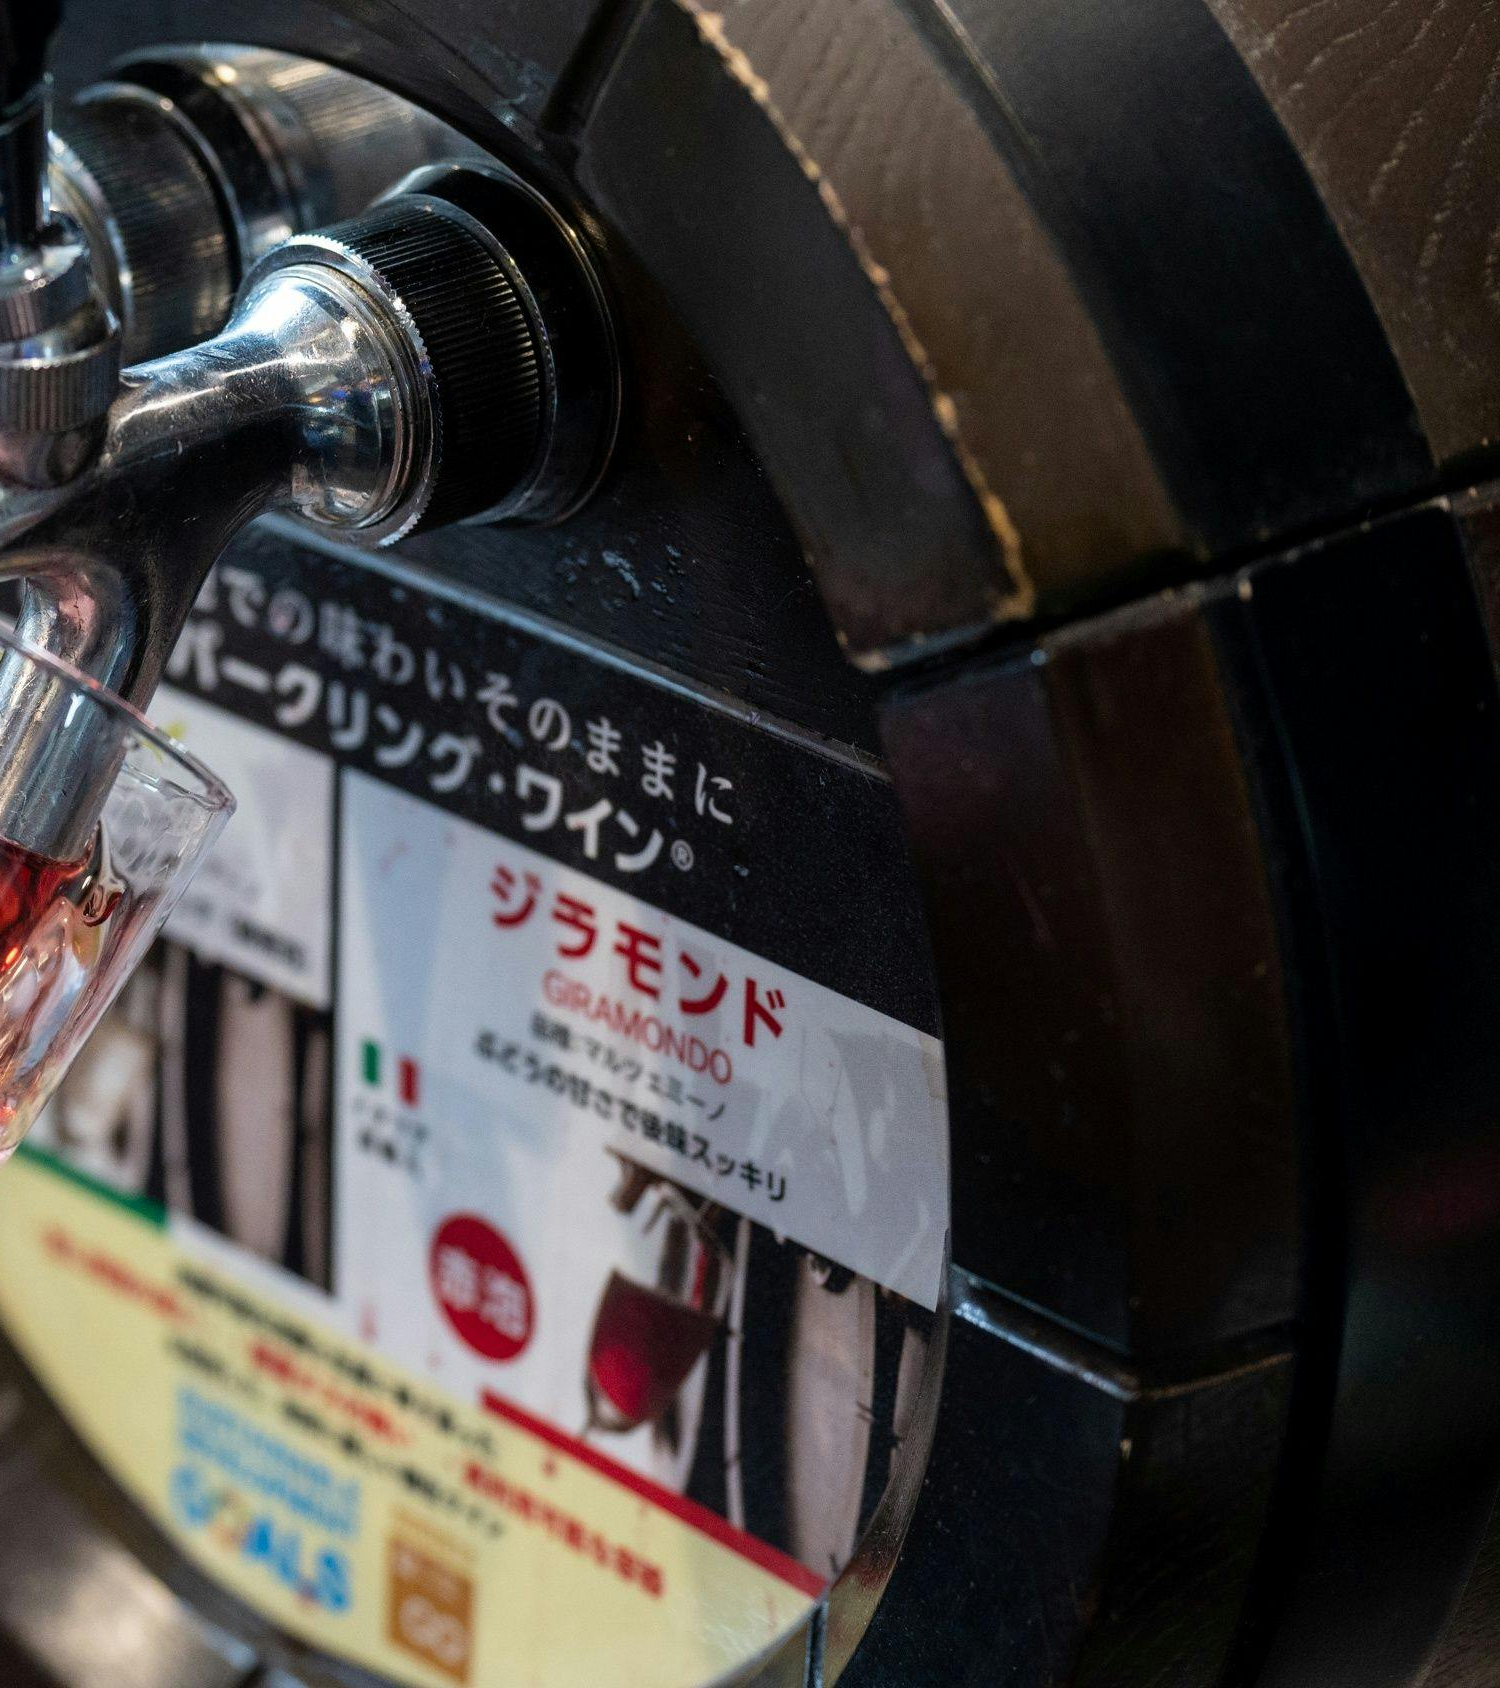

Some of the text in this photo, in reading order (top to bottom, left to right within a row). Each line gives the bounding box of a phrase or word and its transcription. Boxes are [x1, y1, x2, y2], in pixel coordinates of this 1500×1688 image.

[490, 864, 787, 1049] ジラモンド
[541, 968, 733, 1086] GIRAMONDO
[474, 1025, 788, 1203] ぶどうの甘さで後味スッキリ
